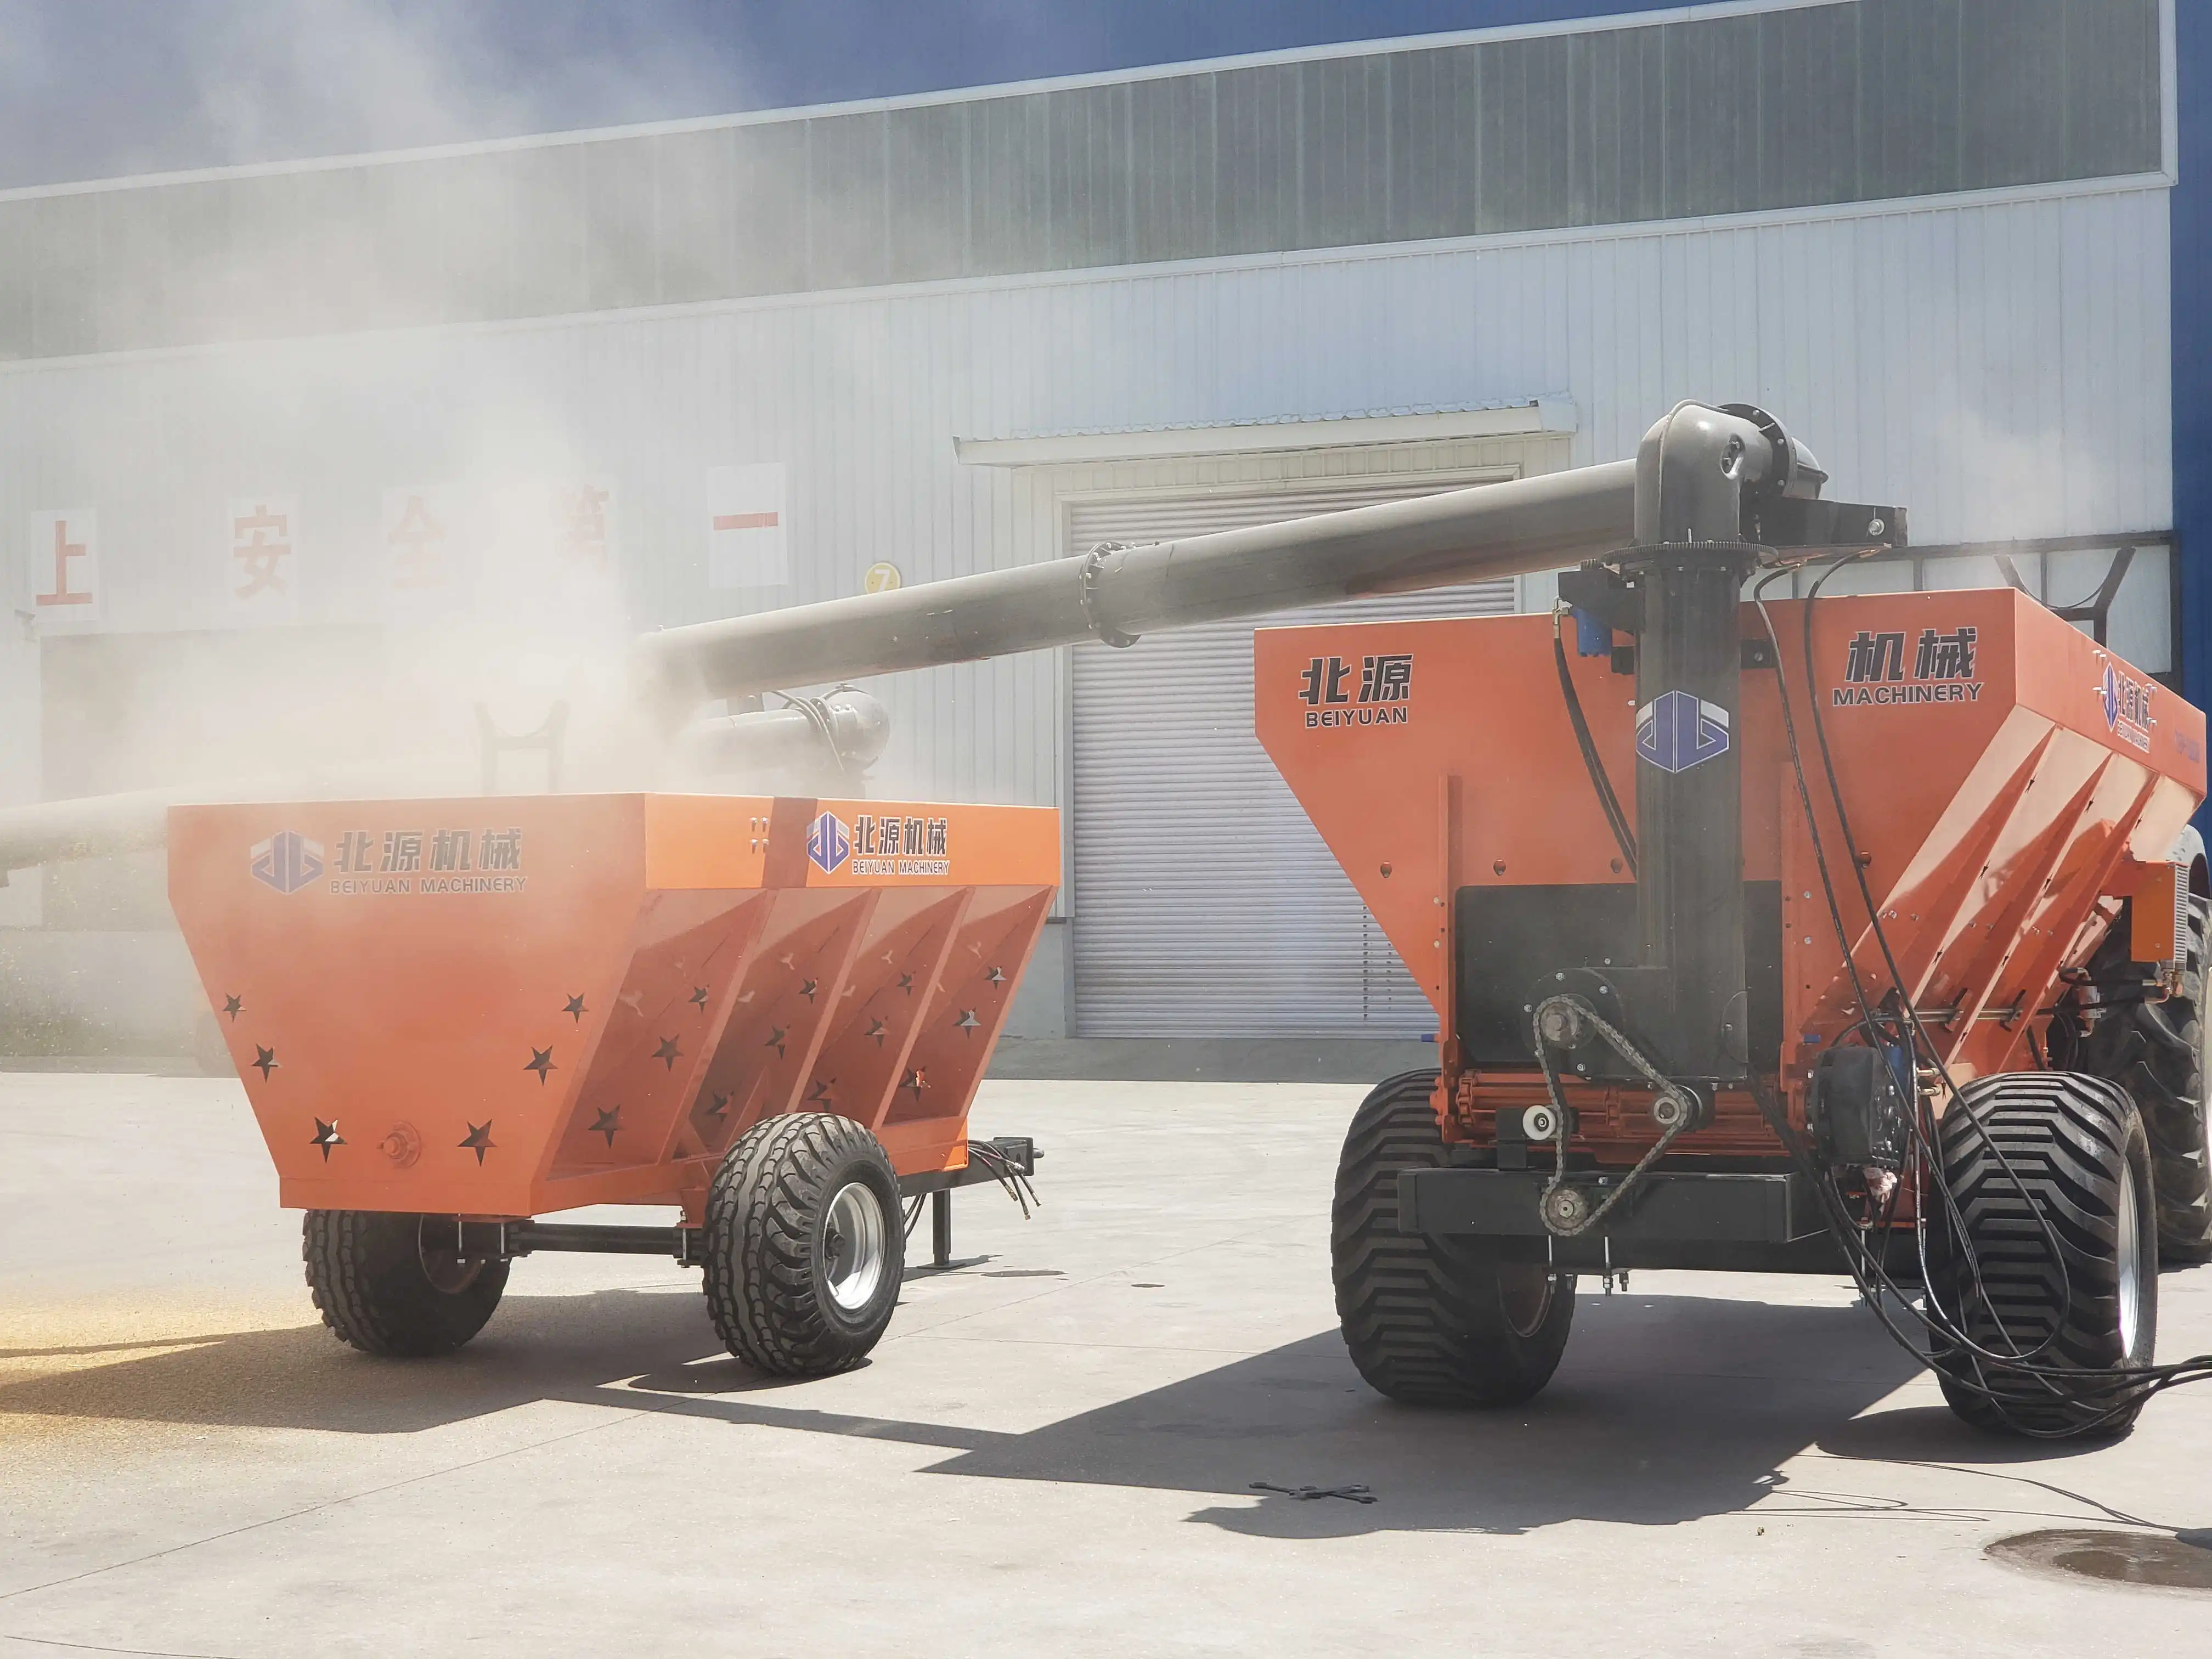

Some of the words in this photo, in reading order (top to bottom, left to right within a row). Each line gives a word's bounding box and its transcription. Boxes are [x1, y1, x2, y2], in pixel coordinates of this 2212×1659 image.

[36, 520, 93, 606] 上
[874, 569, 890, 592] 7
[1299, 653, 1414, 706] 北源
[1845, 627, 1977, 683] 机械
[1305, 706, 1408, 728] BEIYUAN
[1832, 682, 1984, 706] MACHINERY
[332, 826, 523, 873] 北源机械
[853, 814, 948, 857] 北源机械
[330, 878, 411, 895] BEIYUAN
[420, 876, 528, 894] MACHINERY
[852, 859, 895, 875] BEIYUAN
[898, 859, 950, 875] MACHINERY
